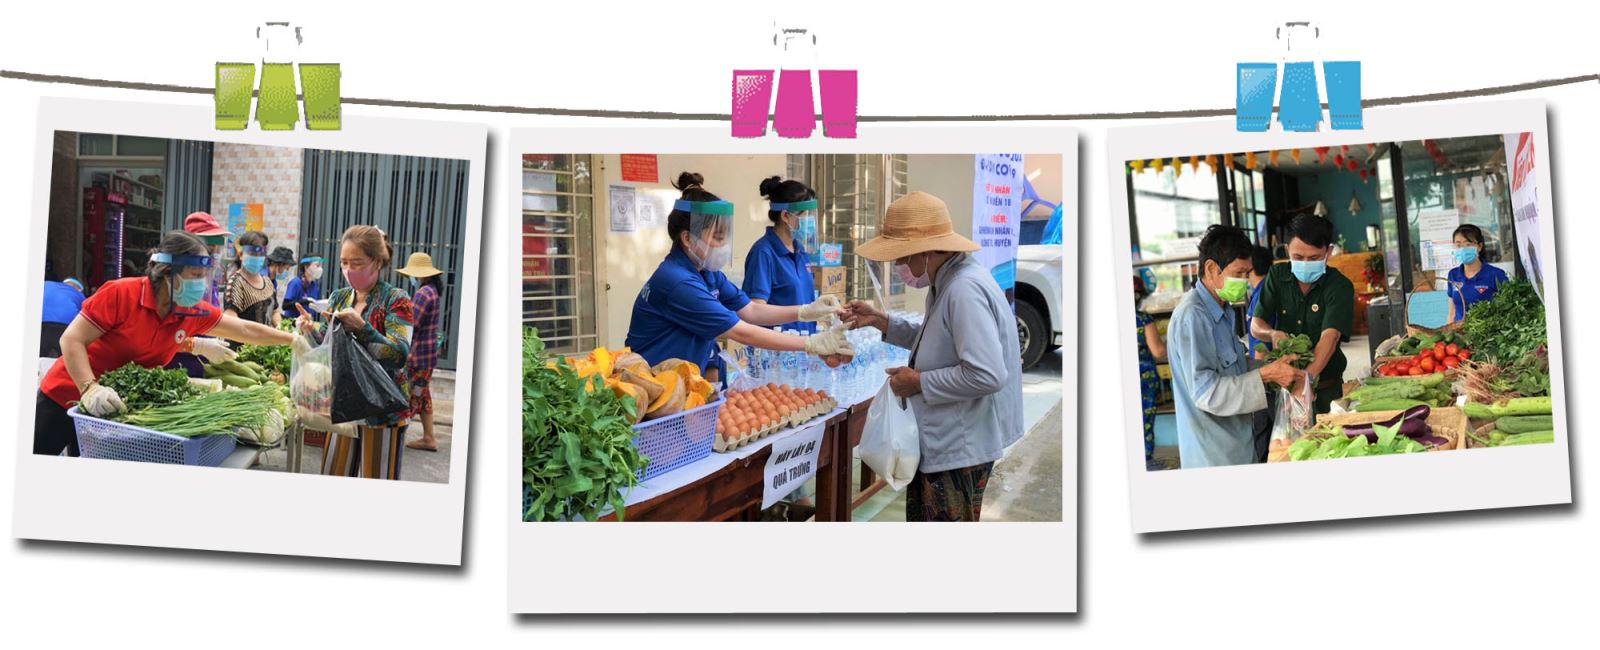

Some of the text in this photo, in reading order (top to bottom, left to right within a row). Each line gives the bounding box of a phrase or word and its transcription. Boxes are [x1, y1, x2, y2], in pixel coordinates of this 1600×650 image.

[804, 440, 817, 453] 04
[773, 461, 811, 490] QUẢ TRỨNG
